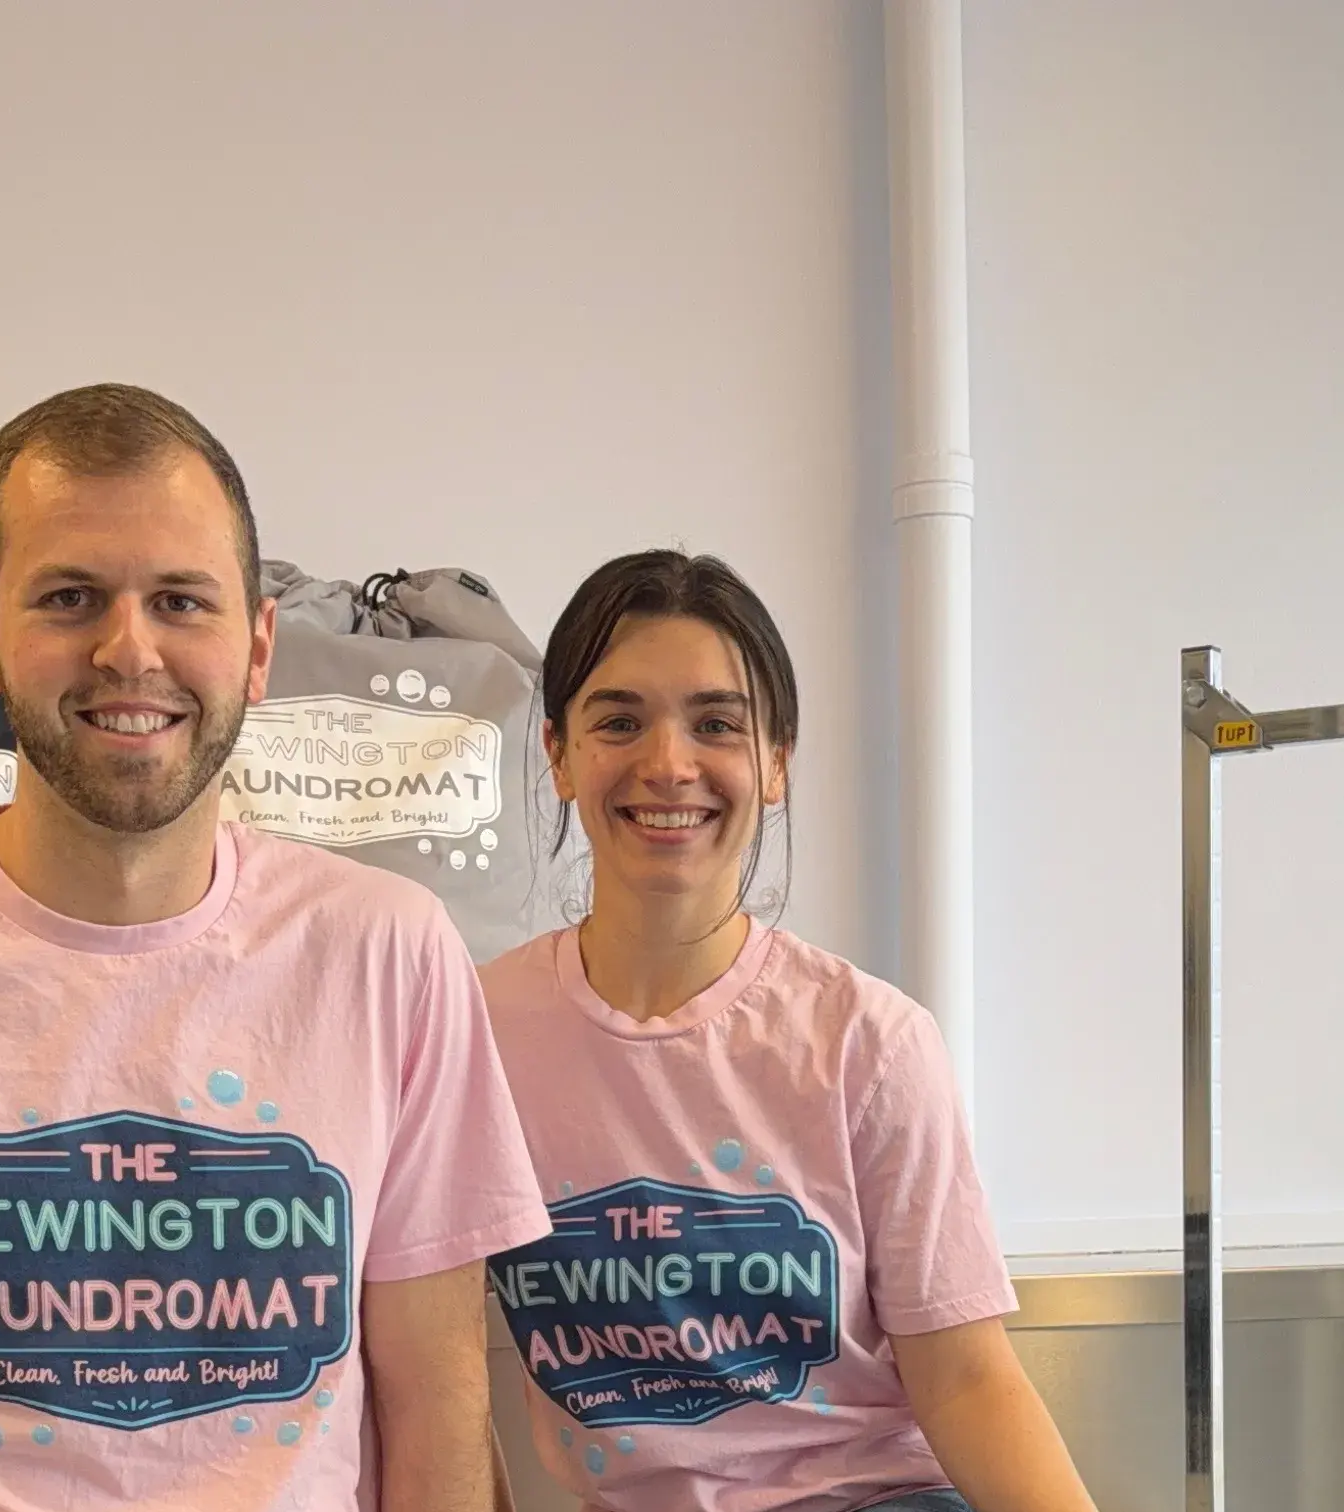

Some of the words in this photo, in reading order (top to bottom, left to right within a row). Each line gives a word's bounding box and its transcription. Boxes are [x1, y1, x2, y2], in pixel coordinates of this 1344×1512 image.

[304, 709, 372, 734] THE
[1226, 727, 1245, 741] UP
[231, 731, 487, 766] EWINGTON
[221, 768, 486, 801] AUNDROMAT
[299, 811, 343, 826] Fresh
[391, 809, 448, 827] Bright!
[81, 1143, 178, 1182] THE
[605, 1205, 683, 1241] THE
[488, 1250, 821, 1309] NEWINGTON
[530, 1312, 823, 1374] AUNDROMAT
[73, 1361, 137, 1385] Fresh
[144, 1360, 189, 1383] and
[199, 1358, 279, 1392] Bright!
[631, 1374, 685, 1400] Fresh
